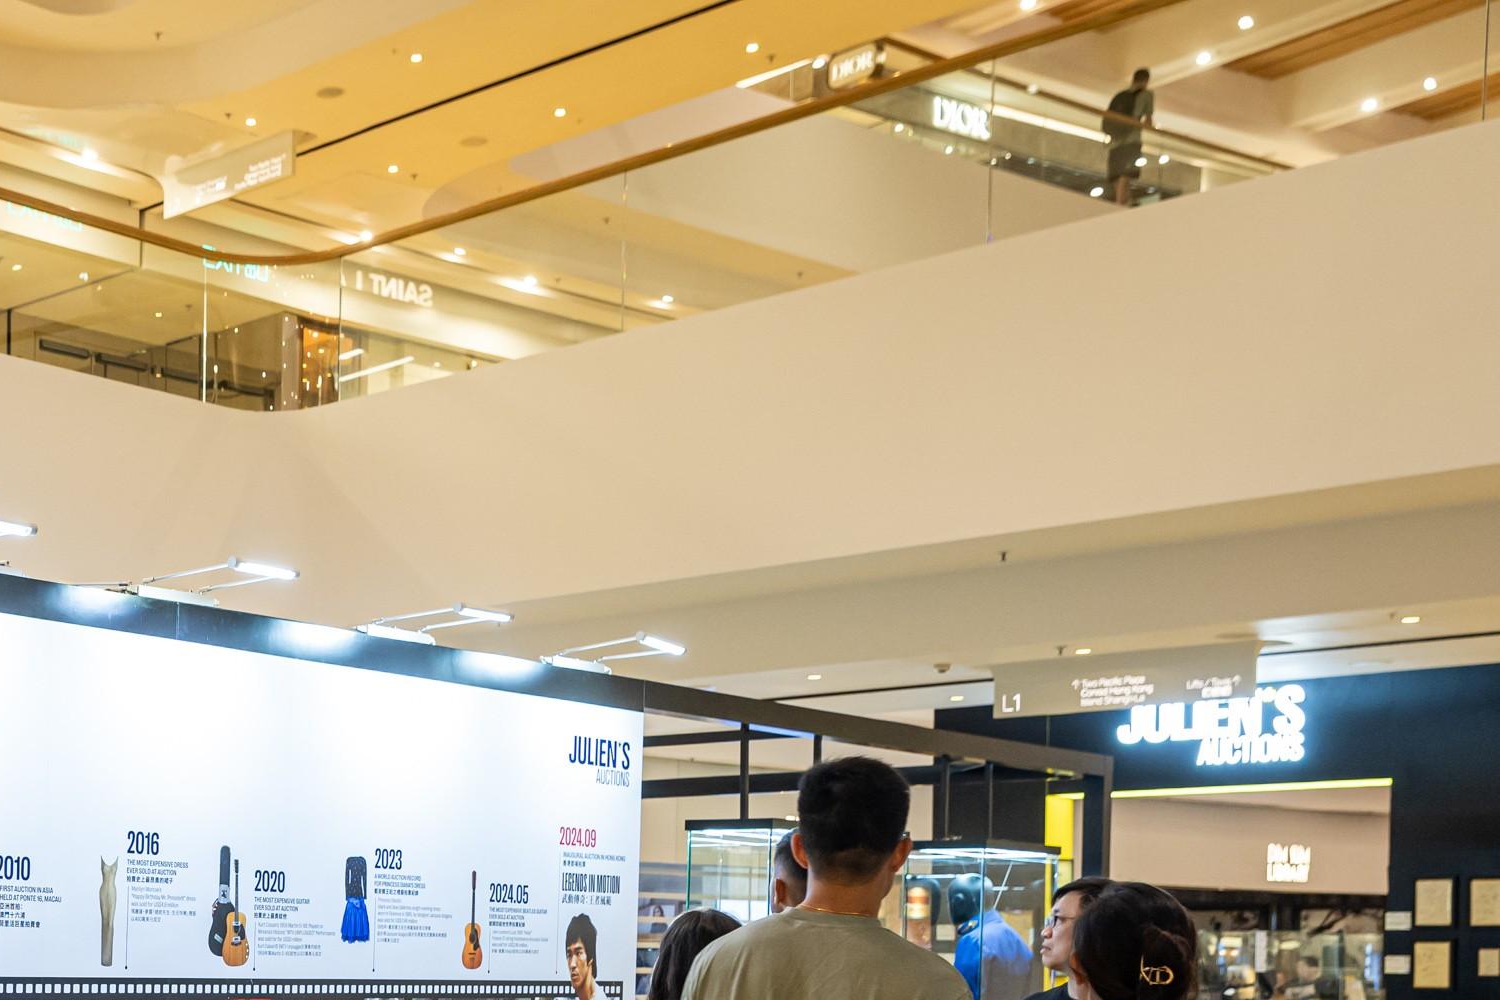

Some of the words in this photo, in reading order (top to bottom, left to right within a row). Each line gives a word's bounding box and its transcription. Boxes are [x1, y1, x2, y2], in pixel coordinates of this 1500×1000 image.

[832, 50, 873, 81] DIOR
[932, 95, 991, 141] DIOR
[1002, 693, 1021, 713] L1
[1196, 732, 1305, 766] AUCTIONS
[596, 769, 630, 787] AUCTIONS
[127, 831, 159, 855] 2016
[559, 826, 596, 848] 2024.09
[375, 848, 402, 870] 2023
[255, 870, 285, 893] 2020
[562, 872, 587, 893] LEGENDS
[588, 874, 596, 893] IN
[596, 875, 620, 894] MOTION
[490, 883, 529, 904] 2024.05
